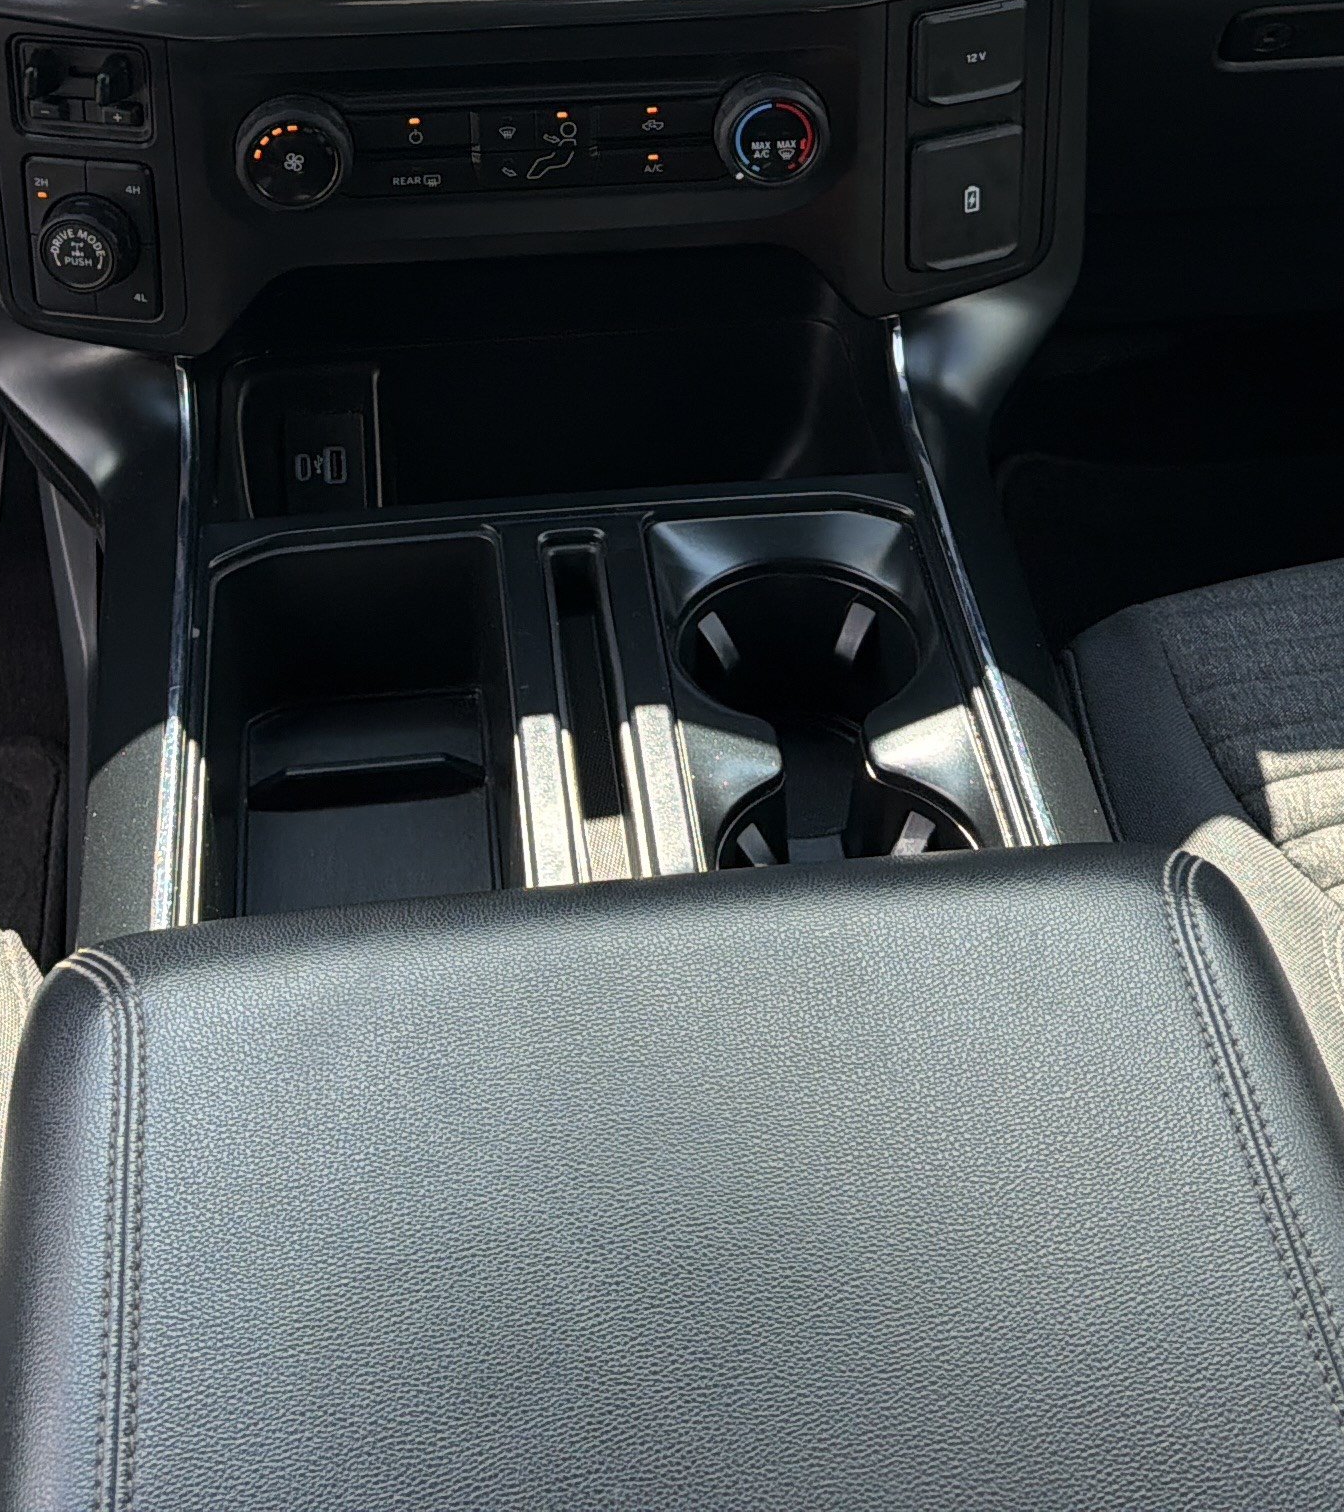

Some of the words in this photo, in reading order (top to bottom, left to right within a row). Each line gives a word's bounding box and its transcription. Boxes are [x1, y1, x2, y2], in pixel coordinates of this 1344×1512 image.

[776, 139, 797, 149] MAX
[753, 149, 770, 159] A/C
[644, 164, 663, 173] A/C
[34, 177, 49, 187] 2H
[392, 176, 421, 186] REAR
[125, 185, 141, 196] 4H
[50, 228, 75, 254] DRIVE
[76, 228, 106, 258] MODE
[64, 255, 93, 267] PUSH
